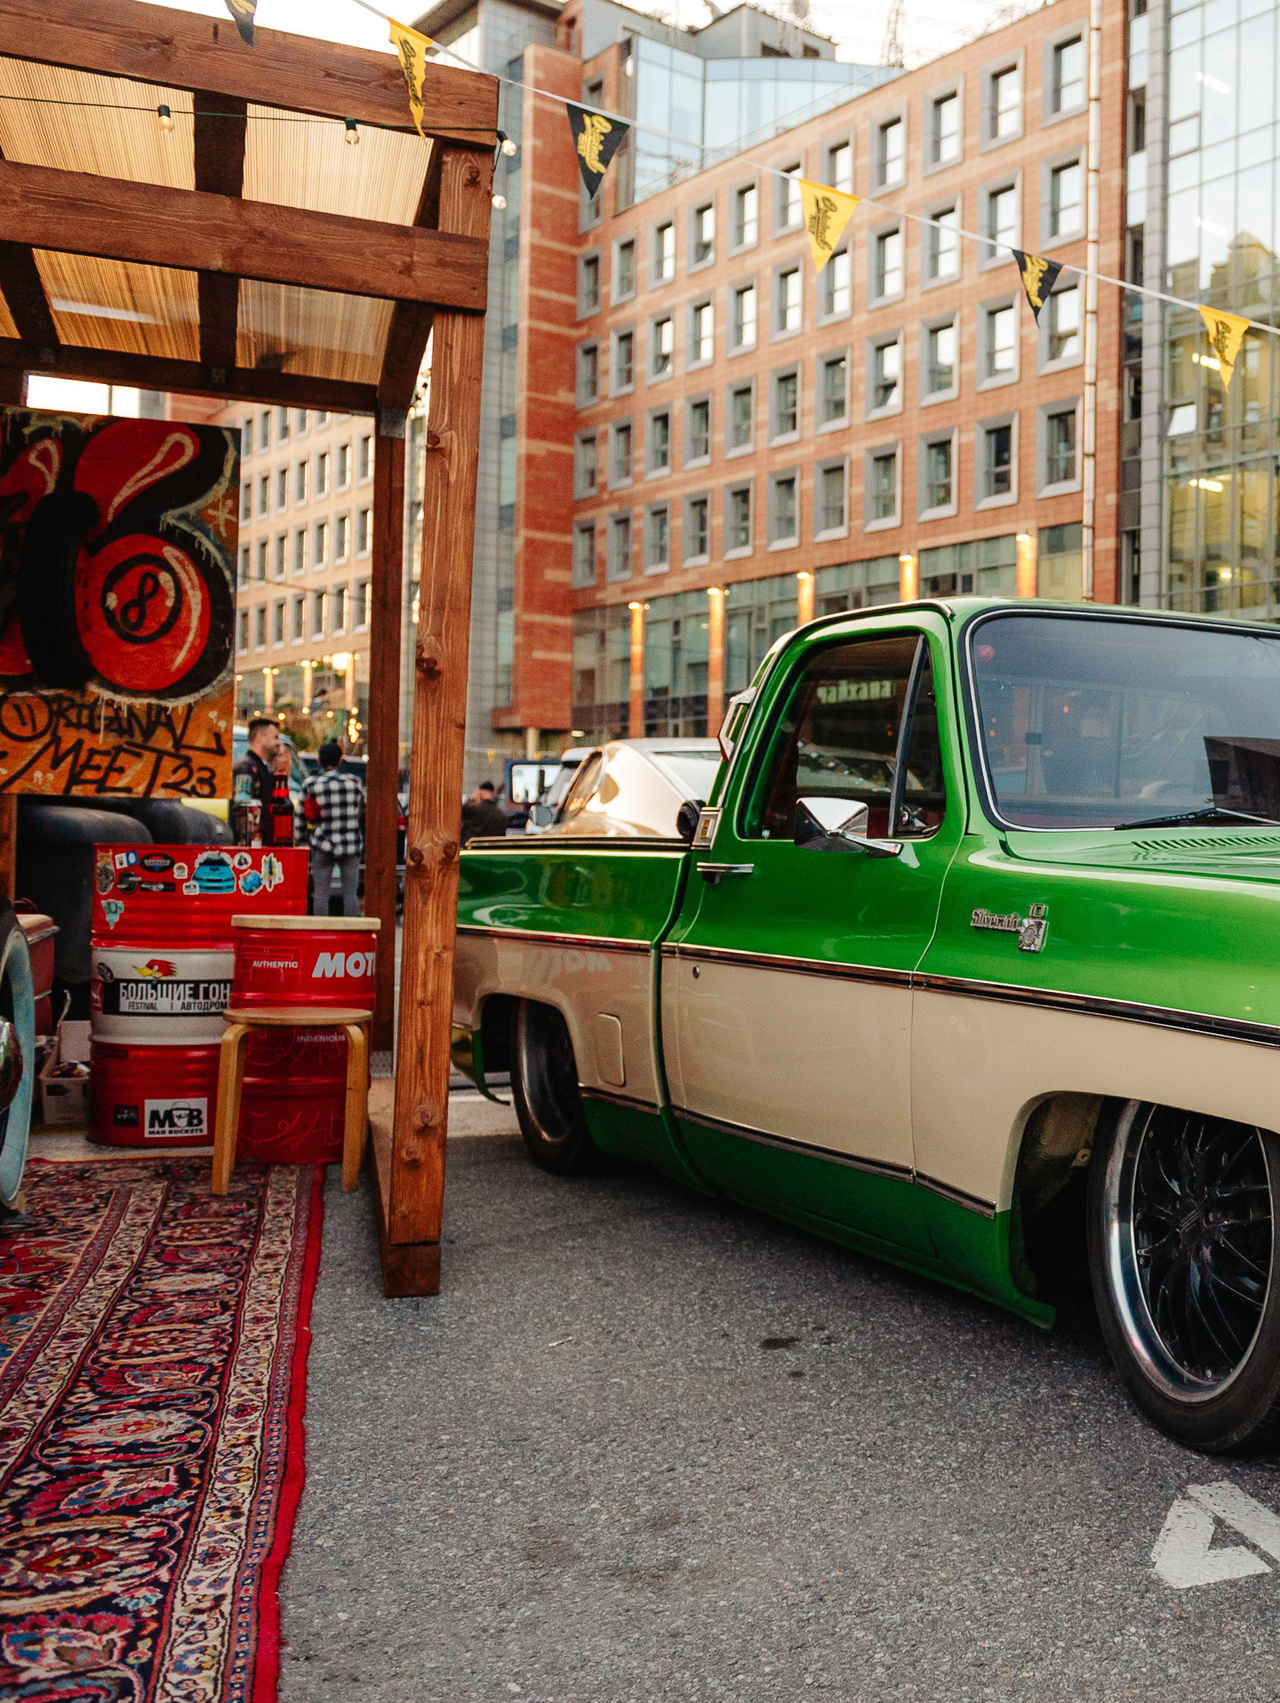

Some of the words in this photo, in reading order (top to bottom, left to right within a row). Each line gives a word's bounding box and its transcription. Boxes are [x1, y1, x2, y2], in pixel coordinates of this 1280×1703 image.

[252, 960, 298, 969] AUTHENTIC
[120, 982, 194, 1000] БОЛЬШИЕ
[128, 1001, 158, 1011] FESTIVAL
[180, 1001, 228, 1011] АВТОДРОМ
